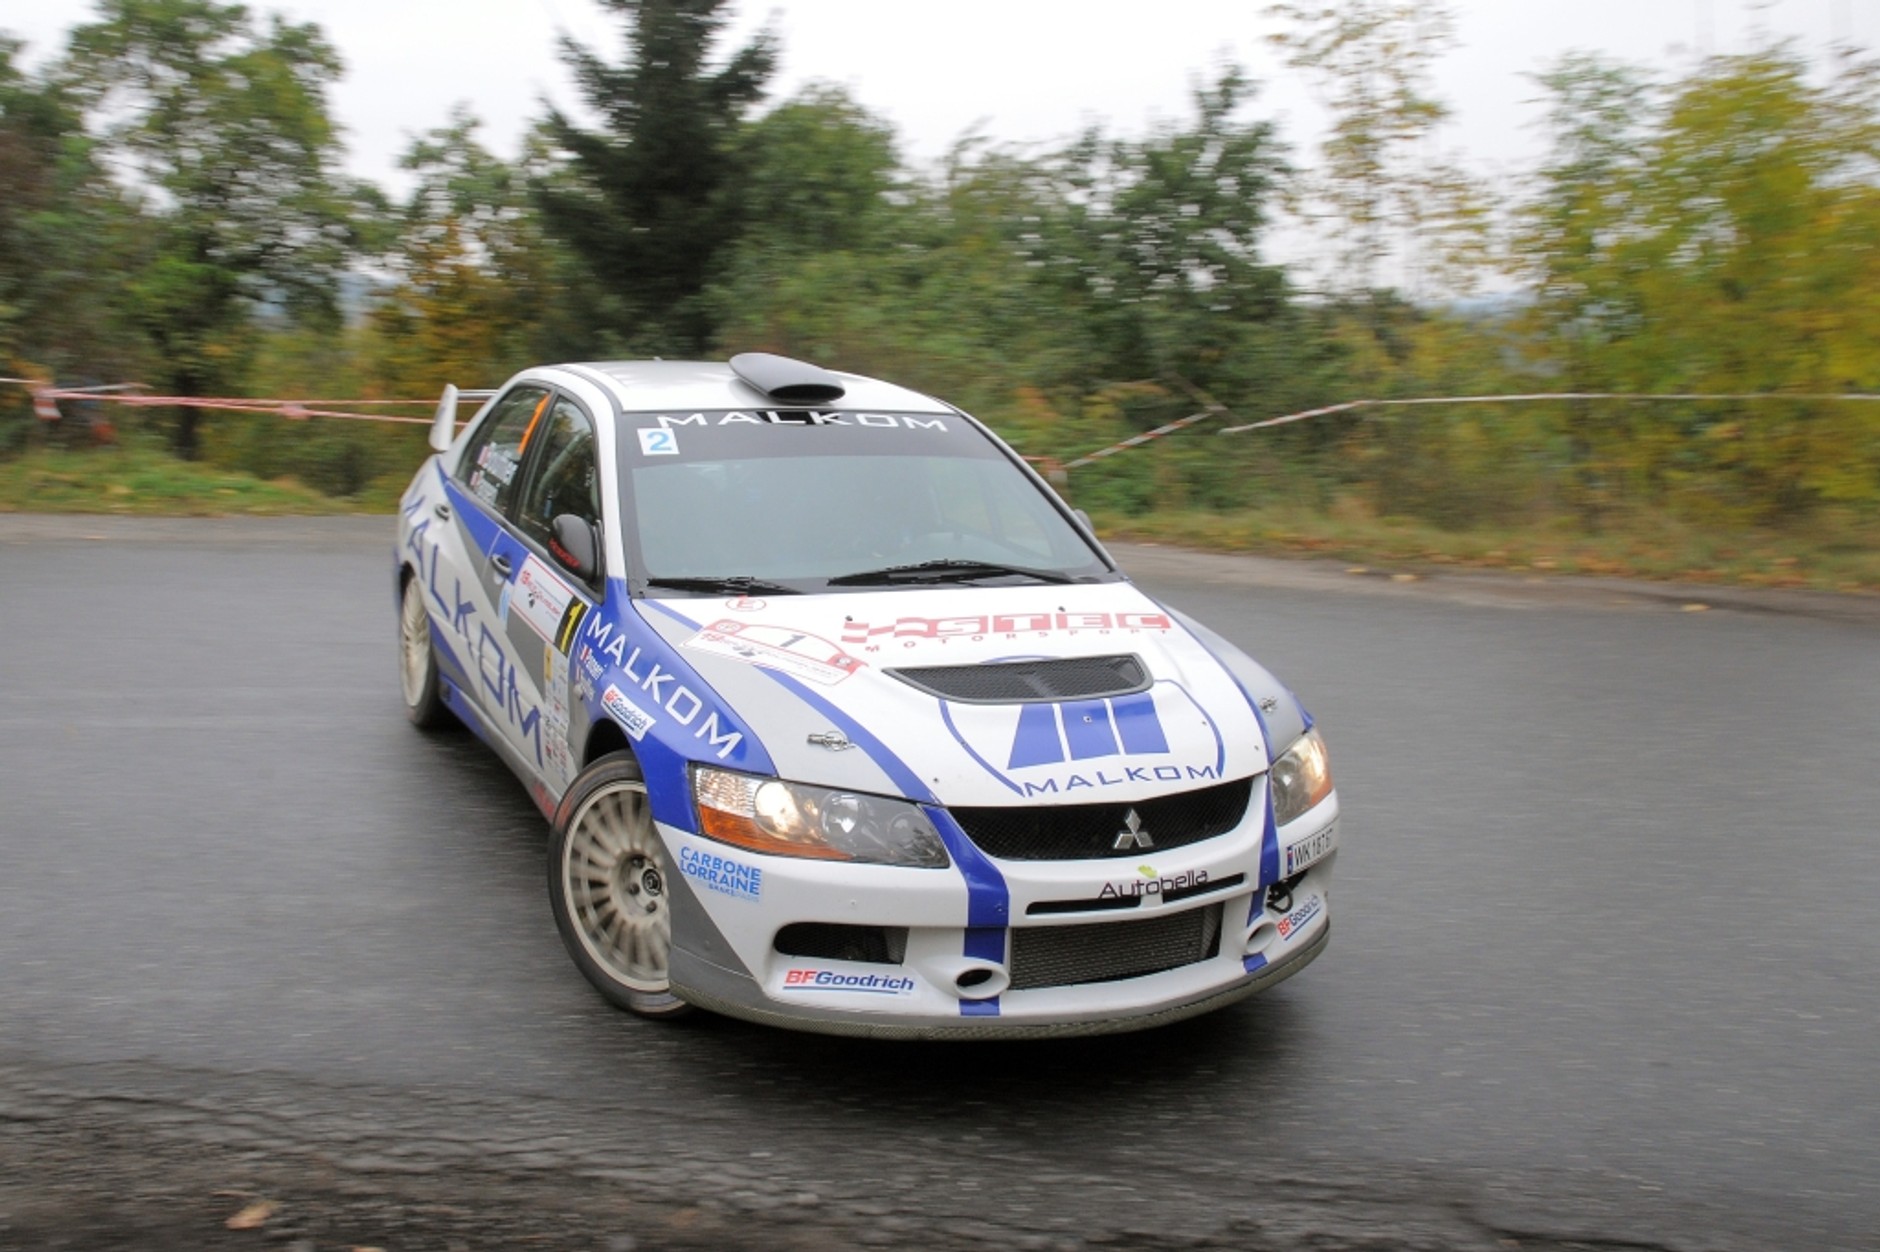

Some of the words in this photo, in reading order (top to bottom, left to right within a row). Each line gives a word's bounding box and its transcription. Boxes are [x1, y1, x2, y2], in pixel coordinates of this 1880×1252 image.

[656, 411, 948, 432] MALKOM
[647, 432, 672, 451] 2
[561, 601, 584, 654] 1
[779, 634, 807, 648] 1
[587, 612, 743, 759] MALKOM
[604, 687, 649, 730] BFGoodrich
[1024, 766, 1215, 797] MALKOM
[680, 859, 760, 896] LORRAINE
[681, 846, 761, 881] CARBONE
[1098, 870, 1208, 899] Autobella
[1277, 894, 1318, 936] BFGoodrich
[785, 970, 914, 990] BFGoodrich
